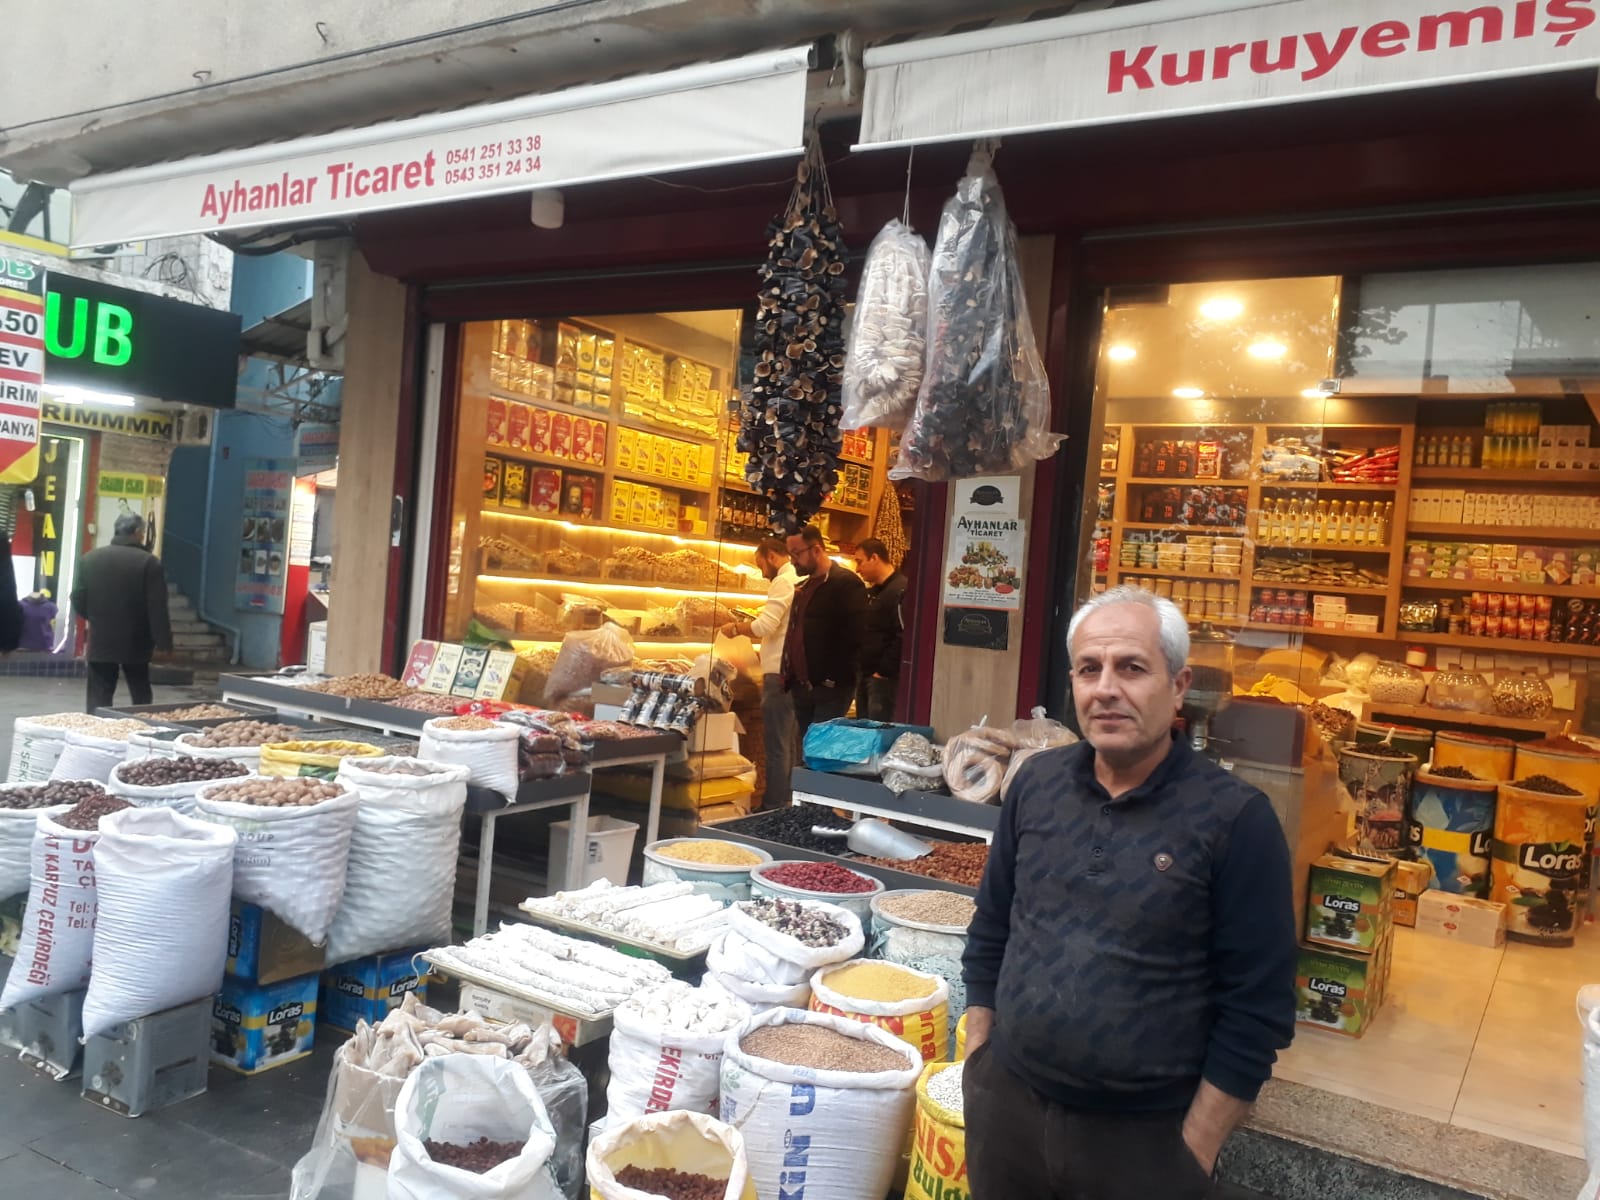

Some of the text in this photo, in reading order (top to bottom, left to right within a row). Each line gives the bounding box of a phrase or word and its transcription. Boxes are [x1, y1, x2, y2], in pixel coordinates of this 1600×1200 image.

[1107, 0, 1596, 94] Kuruyemiş
[446, 135, 542, 165] 0541 251 33 38
[445, 156, 541, 185] 0543 351 24 34
[200, 150, 436, 224] Ayhanlar Ticaret
[0, 419, 35, 438] ANYA
[957, 516, 1018, 532] AYHANLAR
[1524, 846, 1582, 871] Loras
[41, 854, 59, 908] KARPUZ
[1325, 895, 1360, 912] Loras
[27, 909, 56, 986] ÇEKİRDEĞİ
[1310, 978, 1345, 996] Loras
[215, 1005, 241, 1023] Loras
[268, 1003, 302, 1024] Loras
